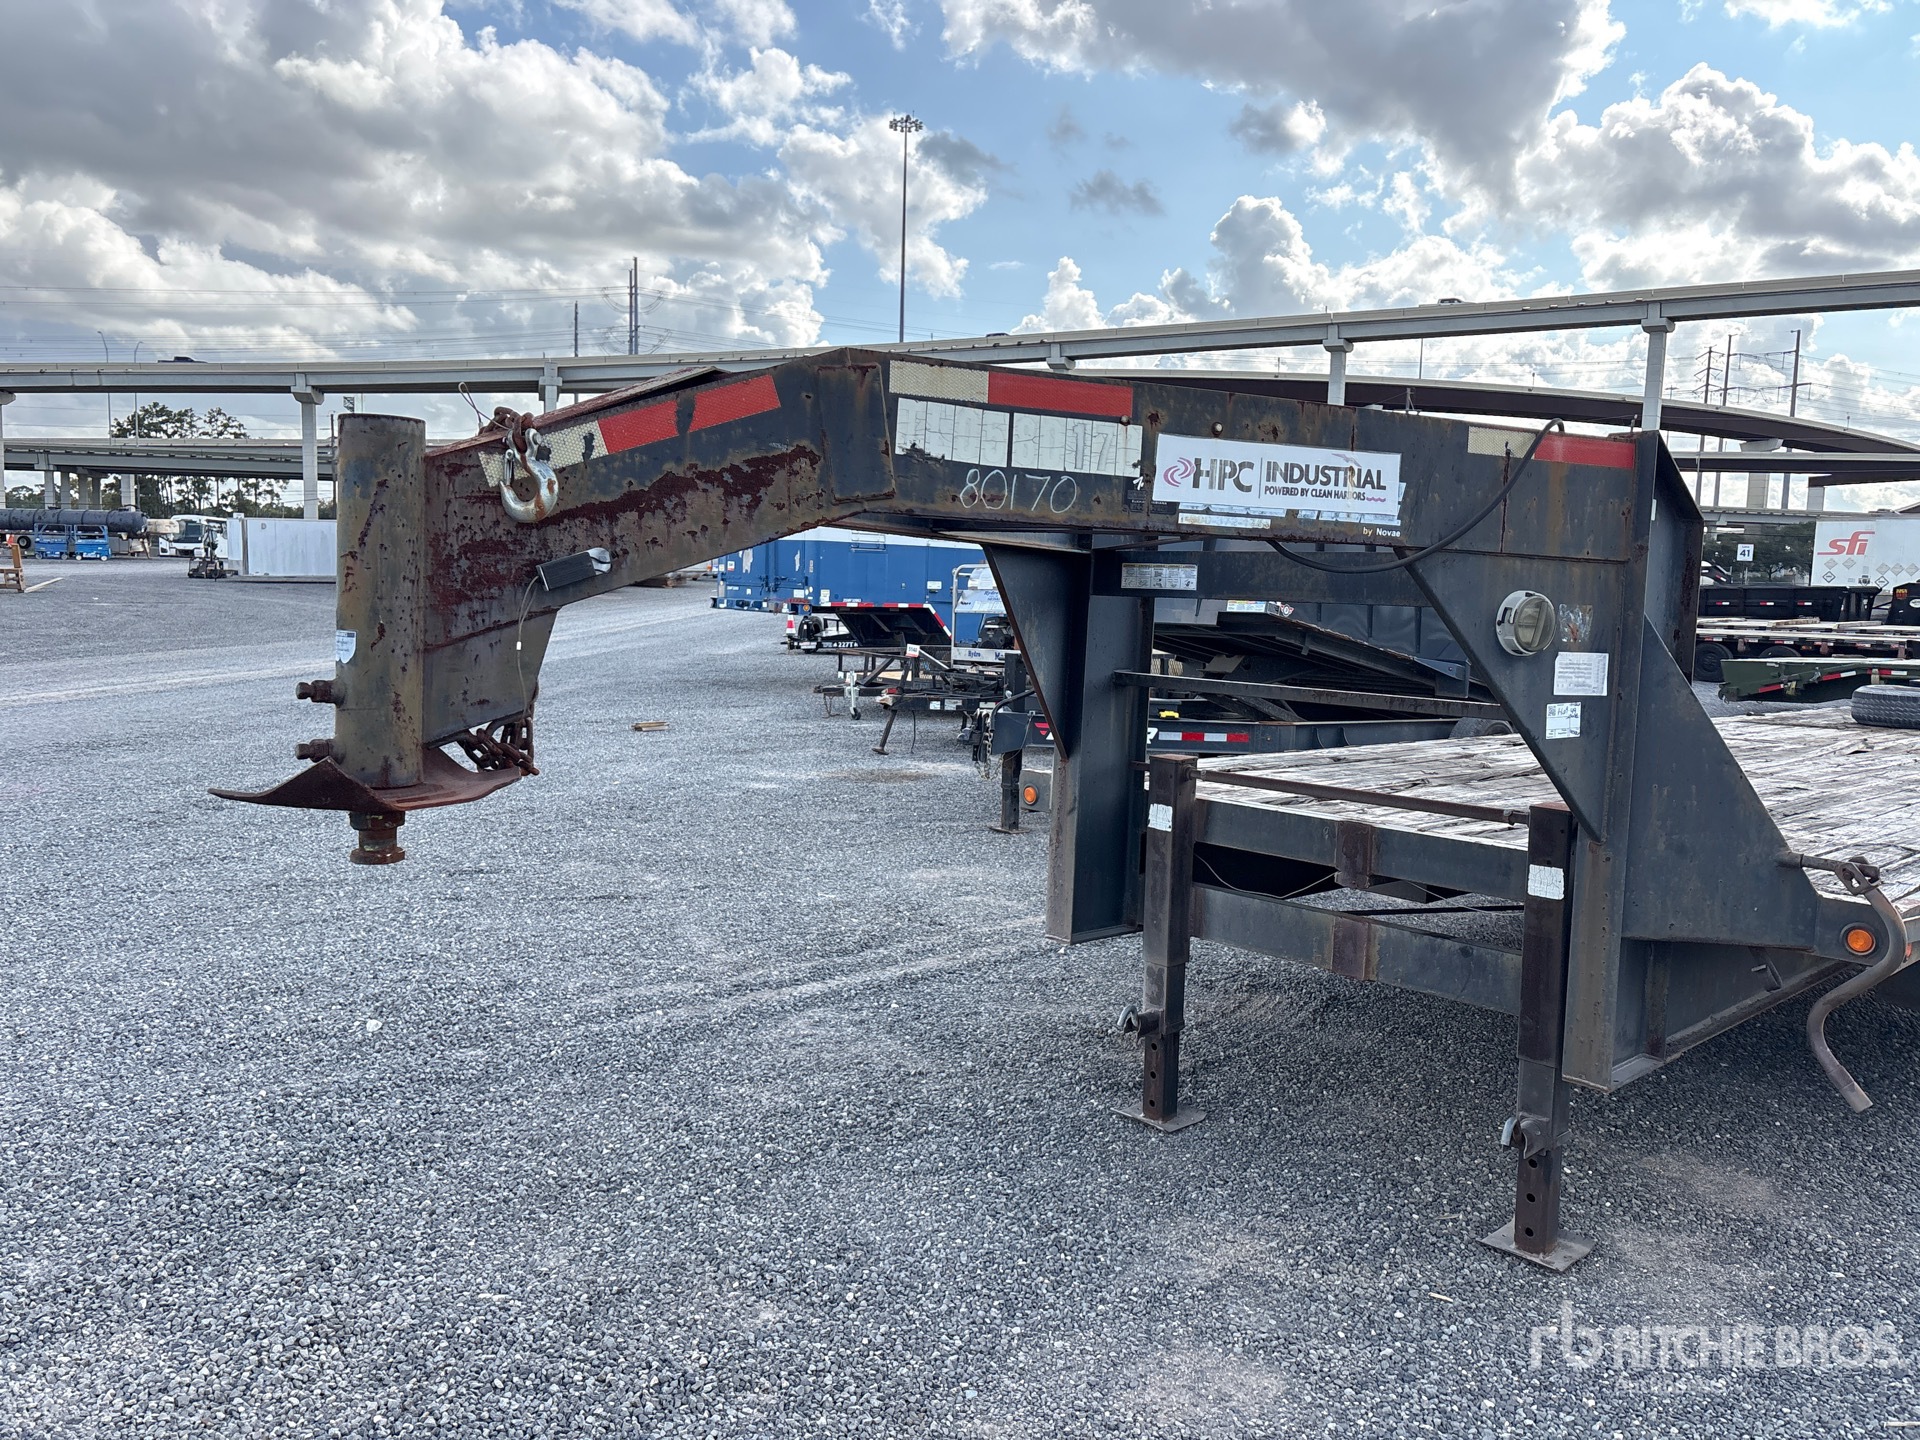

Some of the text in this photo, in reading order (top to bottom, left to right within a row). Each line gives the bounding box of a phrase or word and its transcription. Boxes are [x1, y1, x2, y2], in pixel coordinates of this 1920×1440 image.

[1192, 457, 1255, 493] HPC
[1265, 460, 1387, 491] INDUSTRIAL
[959, 468, 1078, 514] 80170
[1264, 485, 1366, 502] POWERED BY CLEAN HARORS
[1362, 526, 1401, 538] by Novae
[1739, 549, 1751, 557] 41
